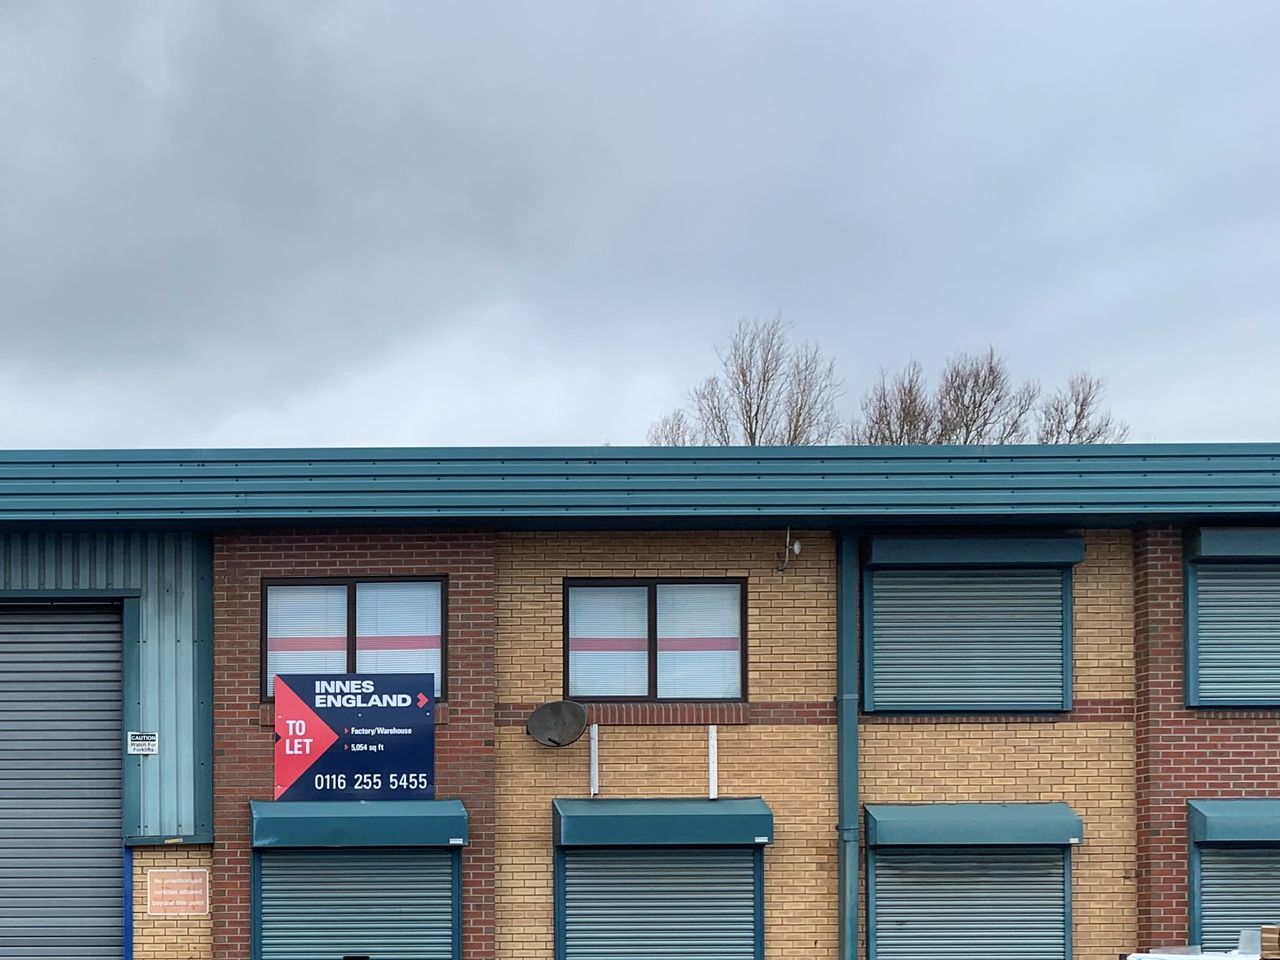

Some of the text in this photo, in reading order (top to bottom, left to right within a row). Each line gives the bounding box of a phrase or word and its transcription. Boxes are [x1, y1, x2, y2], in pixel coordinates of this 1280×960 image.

[315, 680, 375, 694] INNES
[315, 694, 412, 708] ENGLAND
[285, 720, 306, 736] TO
[351, 726, 412, 736] Factory/Warehouse
[285, 738, 313, 755] LET
[369, 744, 377, 753] sq
[378, 743, 385, 752] ft
[314, 773, 428, 790] 0116 255 5455
